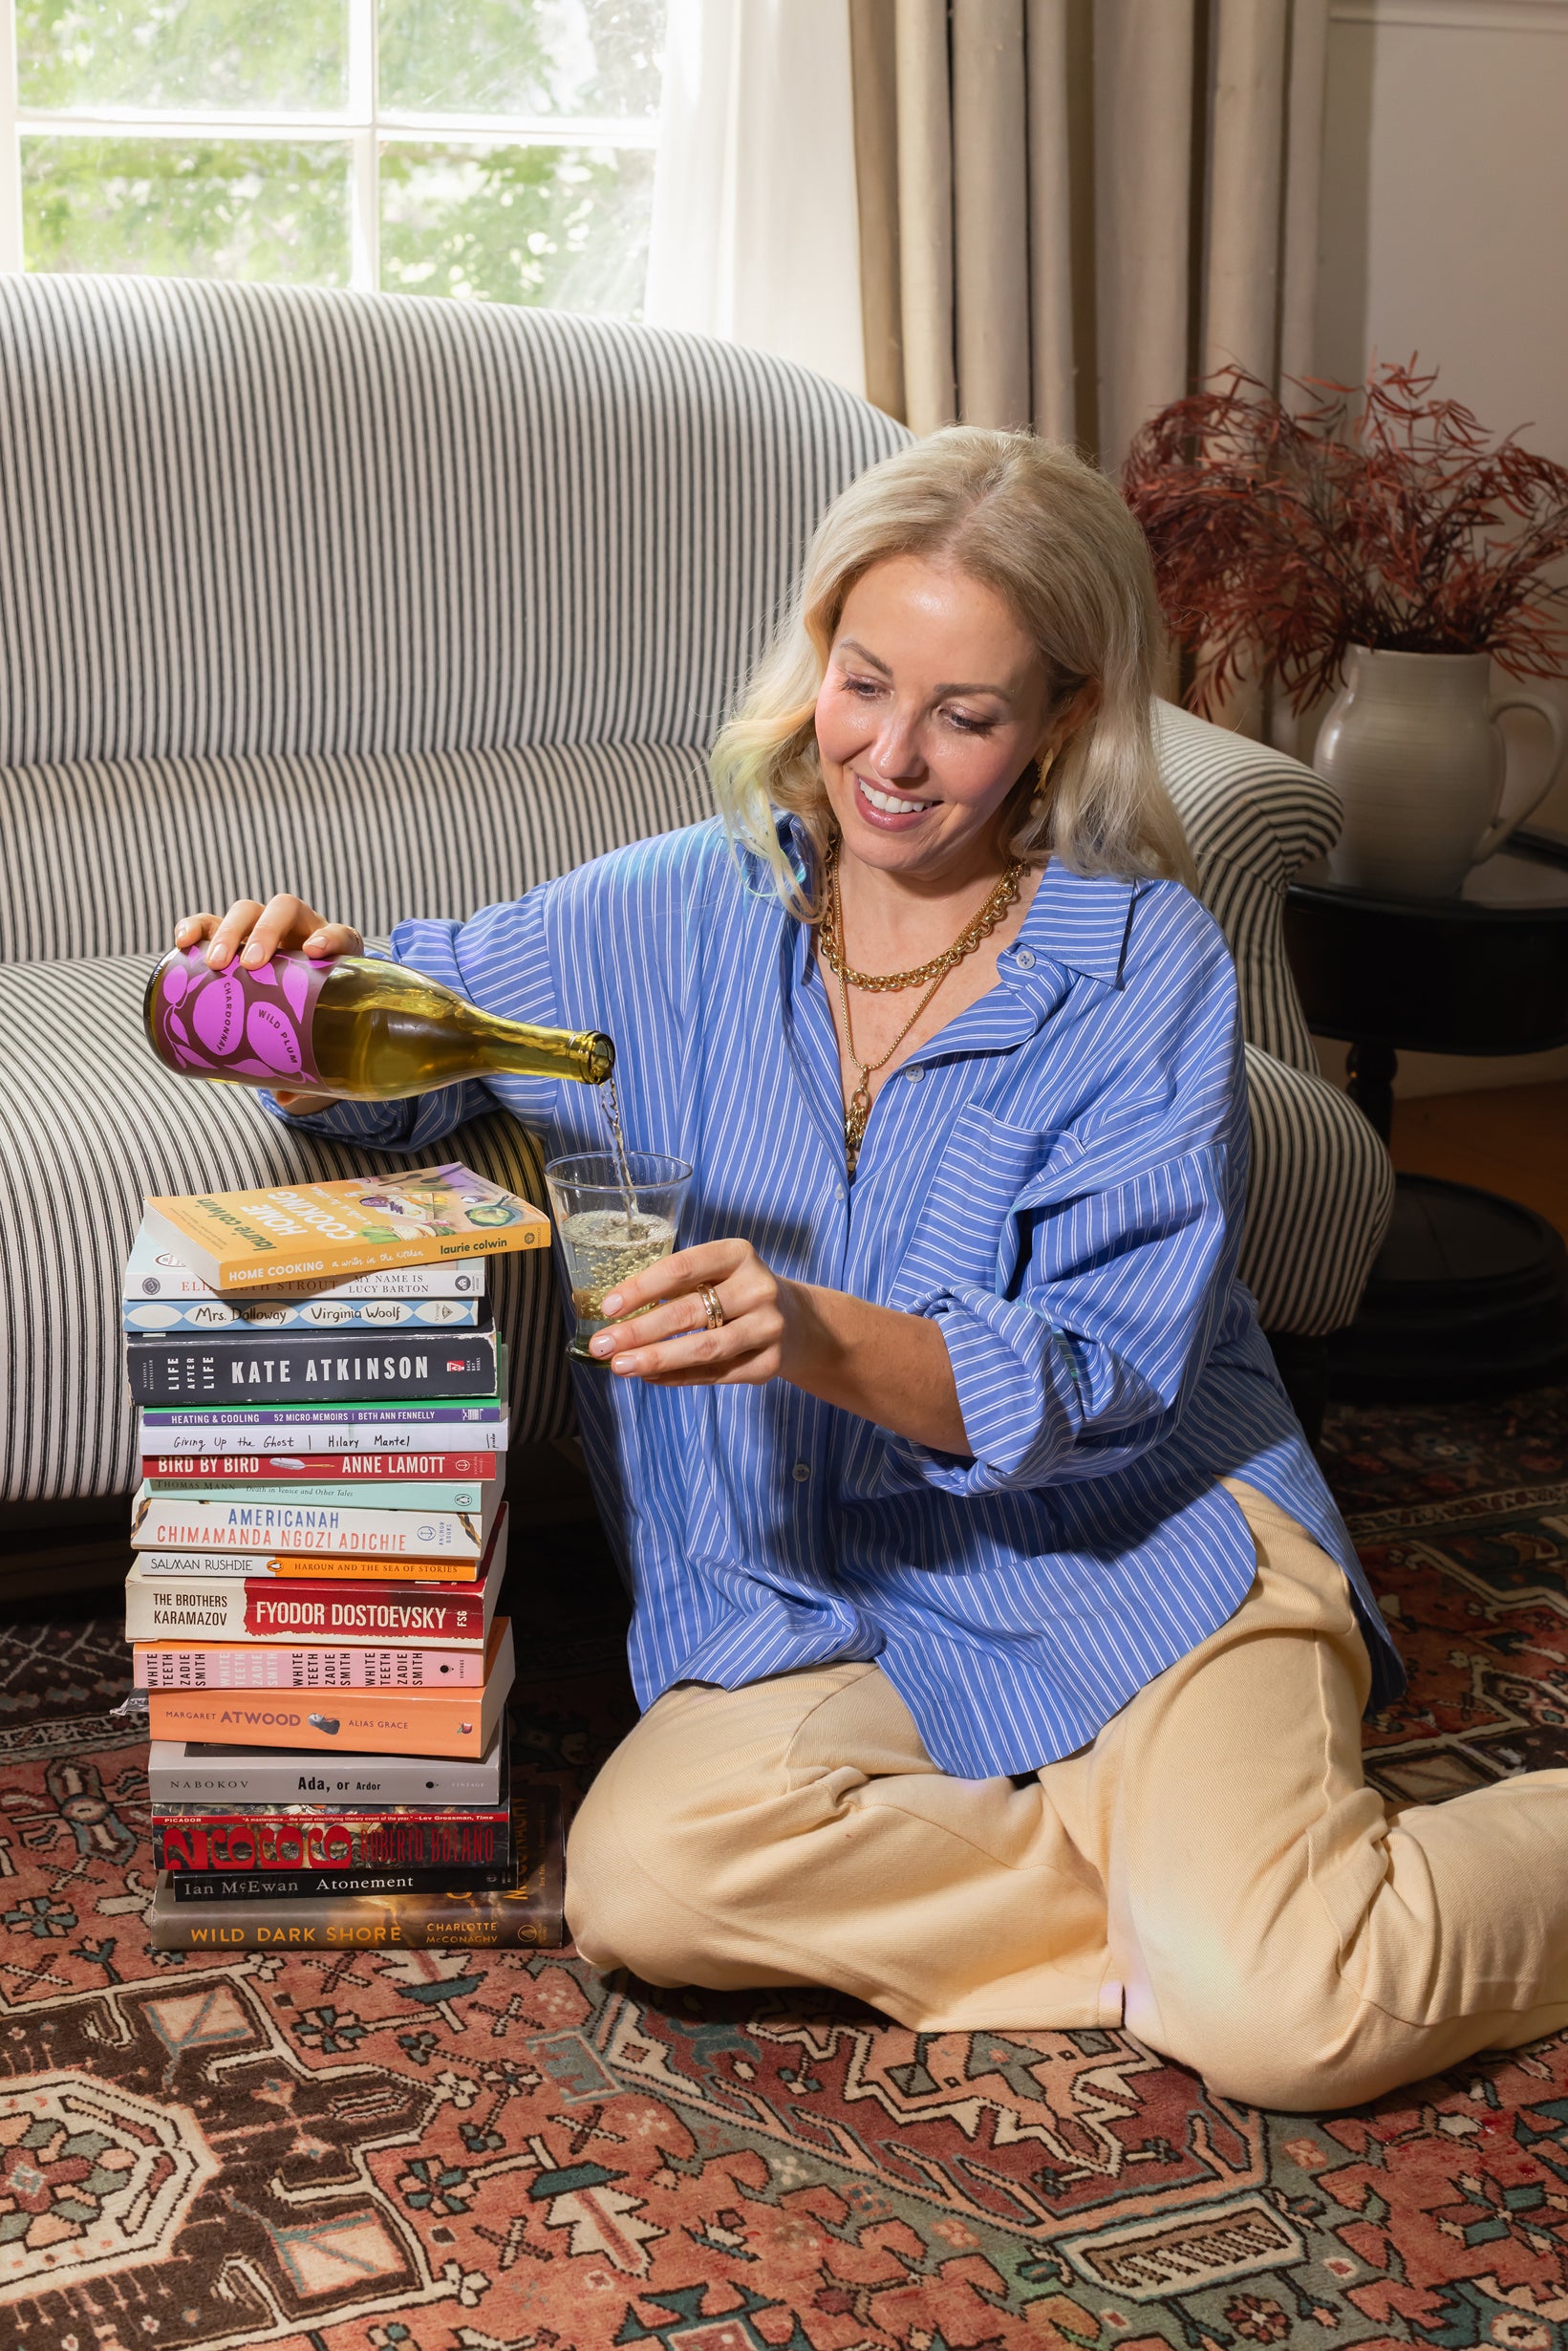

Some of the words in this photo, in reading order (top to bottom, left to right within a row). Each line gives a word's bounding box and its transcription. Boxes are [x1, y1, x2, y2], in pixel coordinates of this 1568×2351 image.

[218, 981, 232, 1052] CHARDONNAY
[258, 1008, 281, 1029] WILD
[280, 1031, 298, 1065] PLUM
[194, 1197, 242, 1229] colwin
[240, 1203, 309, 1237] HOME
[267, 1191, 358, 1240] COOKING
[231, 1226, 277, 1251] laurie
[440, 1241, 471, 1255] laurie
[473, 1238, 507, 1250] colwin
[228, 1268, 264, 1283] HOME
[267, 1261, 324, 1277] COOKING
[277, 1280, 338, 1290] STROUT
[349, 1284, 376, 1293] LUCY
[382, 1284, 429, 1293] BARTON
[195, 1307, 226, 1322] Mrs.
[230, 1306, 287, 1325] Dalloway
[311, 1306, 362, 1323] Virginia
[365, 1306, 401, 1321] Woolf
[167, 1358, 180, 1391] LIFE
[186, 1358, 196, 1389] AFTER
[203, 1356, 215, 1389] LIFE
[231, 1360, 290, 1384] KATE
[305, 1356, 428, 1382] ATKINSON
[171, 1414, 209, 1424] HEATING
[212, 1414, 218, 1423] &
[221, 1413, 260, 1423] COOLING
[274, 1413, 284, 1422] 52
[286, 1413, 349, 1422] MICRO-MEMOIRS
[358, 1413, 378, 1421] BETH
[379, 1412, 397, 1420] ANN
[397, 1411, 436, 1420] FENNELLY
[173, 1436, 205, 1452] Giving
[214, 1436, 227, 1450] Up
[237, 1436, 255, 1447] the
[263, 1435, 294, 1448] Ghost
[328, 1435, 359, 1449] Hilary
[374, 1434, 410, 1447] Mantel
[158, 1456, 194, 1473] BIRD
[200, 1456, 218, 1473] BY
[224, 1456, 259, 1473] BIRD
[342, 1456, 382, 1474] ANNE
[388, 1456, 445, 1474] LAMOTT
[156, 1479, 200, 1490] THOMAS
[204, 1481, 236, 1490] MANN
[227, 1508, 339, 1529] AMERICANAH
[157, 1525, 272, 1545] CHIMAMANDA
[280, 1530, 331, 1549] NGOZI
[338, 1532, 407, 1551] ADICHIE
[151, 1558, 201, 1570] SALMAN
[204, 1559, 253, 1571] RUSHDIE
[294, 1563, 334, 1571] HAROUN
[419, 1564, 458, 1573] STORIES
[153, 1593, 172, 1606] THE
[176, 1594, 227, 1607] BROTHERS
[154, 1610, 227, 1626] KARAMAZOV
[256, 1601, 325, 1626] FYODOR
[332, 1604, 447, 1629] DOSTOEVSKY
[457, 1610, 467, 1627] FSG
[147, 1653, 158, 1687] WHITE
[162, 1653, 174, 1687] TEETH
[180, 1653, 190, 1687] ZADIE
[195, 1653, 206, 1687] SMITH
[219, 1652, 230, 1686] WHITE
[234, 1652, 246, 1686] TEETH
[252, 1652, 263, 1686] ZADIE
[267, 1652, 278, 1686] SMITH
[292, 1652, 303, 1686] WHITE
[308, 1652, 319, 1686] TEETH
[325, 1652, 335, 1686] ZADIE
[340, 1652, 351, 1686] SMITH
[365, 1652, 376, 1686] WHITE
[380, 1652, 391, 1686] TEETH
[397, 1652, 408, 1686] ZADIE
[412, 1652, 423, 1686] SMITH
[165, 1711, 218, 1720] MARGARET
[220, 1711, 302, 1727] ATWOOD
[348, 1719, 375, 1728] ALIAS
[377, 1720, 408, 1729] GRACE
[170, 1780, 249, 1789] NABOKOV
[298, 1777, 331, 1792] Ada,
[336, 1780, 351, 1790] or
[356, 1781, 381, 1791] Ardor
[360, 1828, 423, 1863] ROBERTO
[432, 1824, 494, 1863] BOLAÑO
[184, 1883, 214, 1895] Ian
[222, 1880, 299, 1894] McEwan
[316, 1877, 414, 1890] Atonement
[191, 1928, 246, 1942] WILD
[257, 1927, 316, 1942] DARK
[326, 1926, 402, 1942] SHORE
[426, 1922, 498, 1931] CHARLOTTE
[425, 1935, 498, 1944] McCONAGHY
